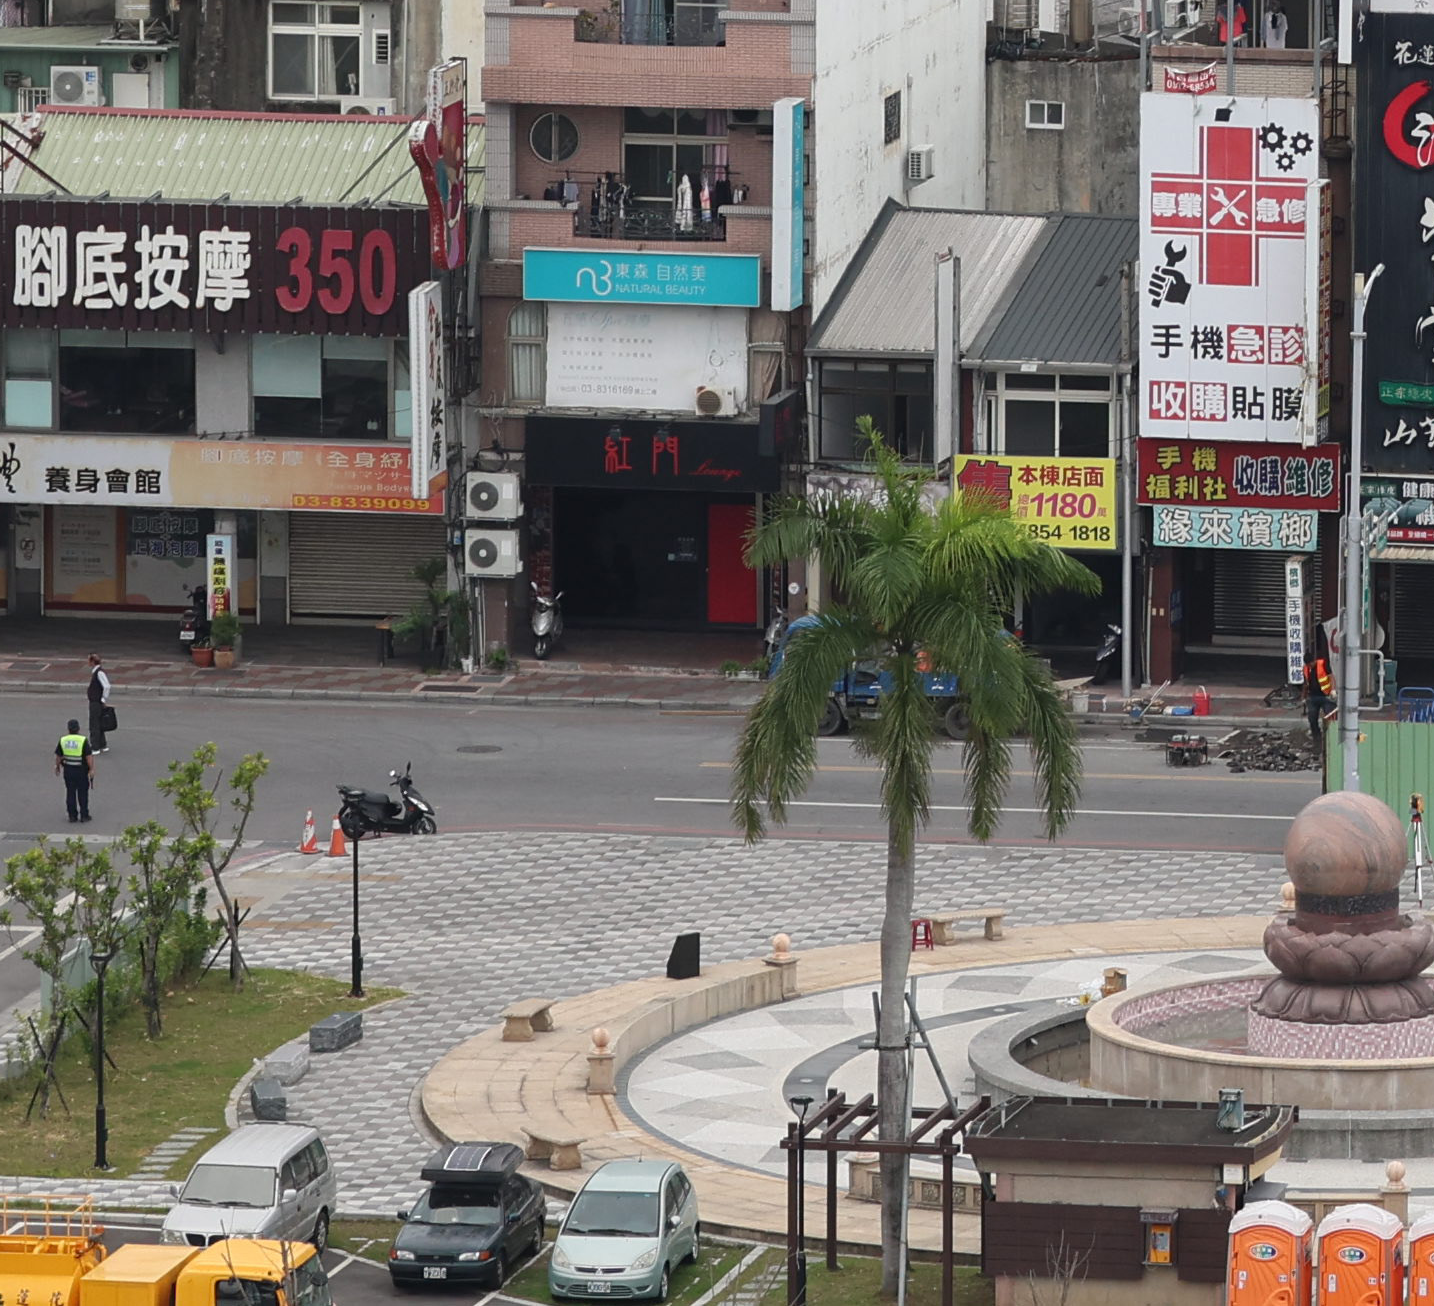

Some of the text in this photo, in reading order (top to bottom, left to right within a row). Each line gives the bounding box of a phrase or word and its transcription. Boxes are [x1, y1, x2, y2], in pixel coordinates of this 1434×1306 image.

[1152, 192, 1203, 218] 專業
[1256, 197, 1306, 224] 急修
[12, 224, 396, 316] 腳底按摩 350
[656, 263, 706, 282] 自然美
[616, 284, 706, 295] NATURAL BEAUTY
[1150, 323, 1304, 364] 手機急診
[1150, 379, 1304, 421] 收購貼膜
[604, 436, 680, 475] 紅門
[44, 466, 162, 496] 養身會館
[1017, 464, 1105, 488] 本棟店面
[1156, 446, 1334, 498] 手機 收購維修
[1145, 473, 1229, 502] 福利社
[292, 494, 431, 511] 03-8339099
[1031, 492, 1098, 519] 1180
[1158, 507, 1313, 549] 緣來檳榔
[1288, 600, 1303, 683] 手機收購維修
